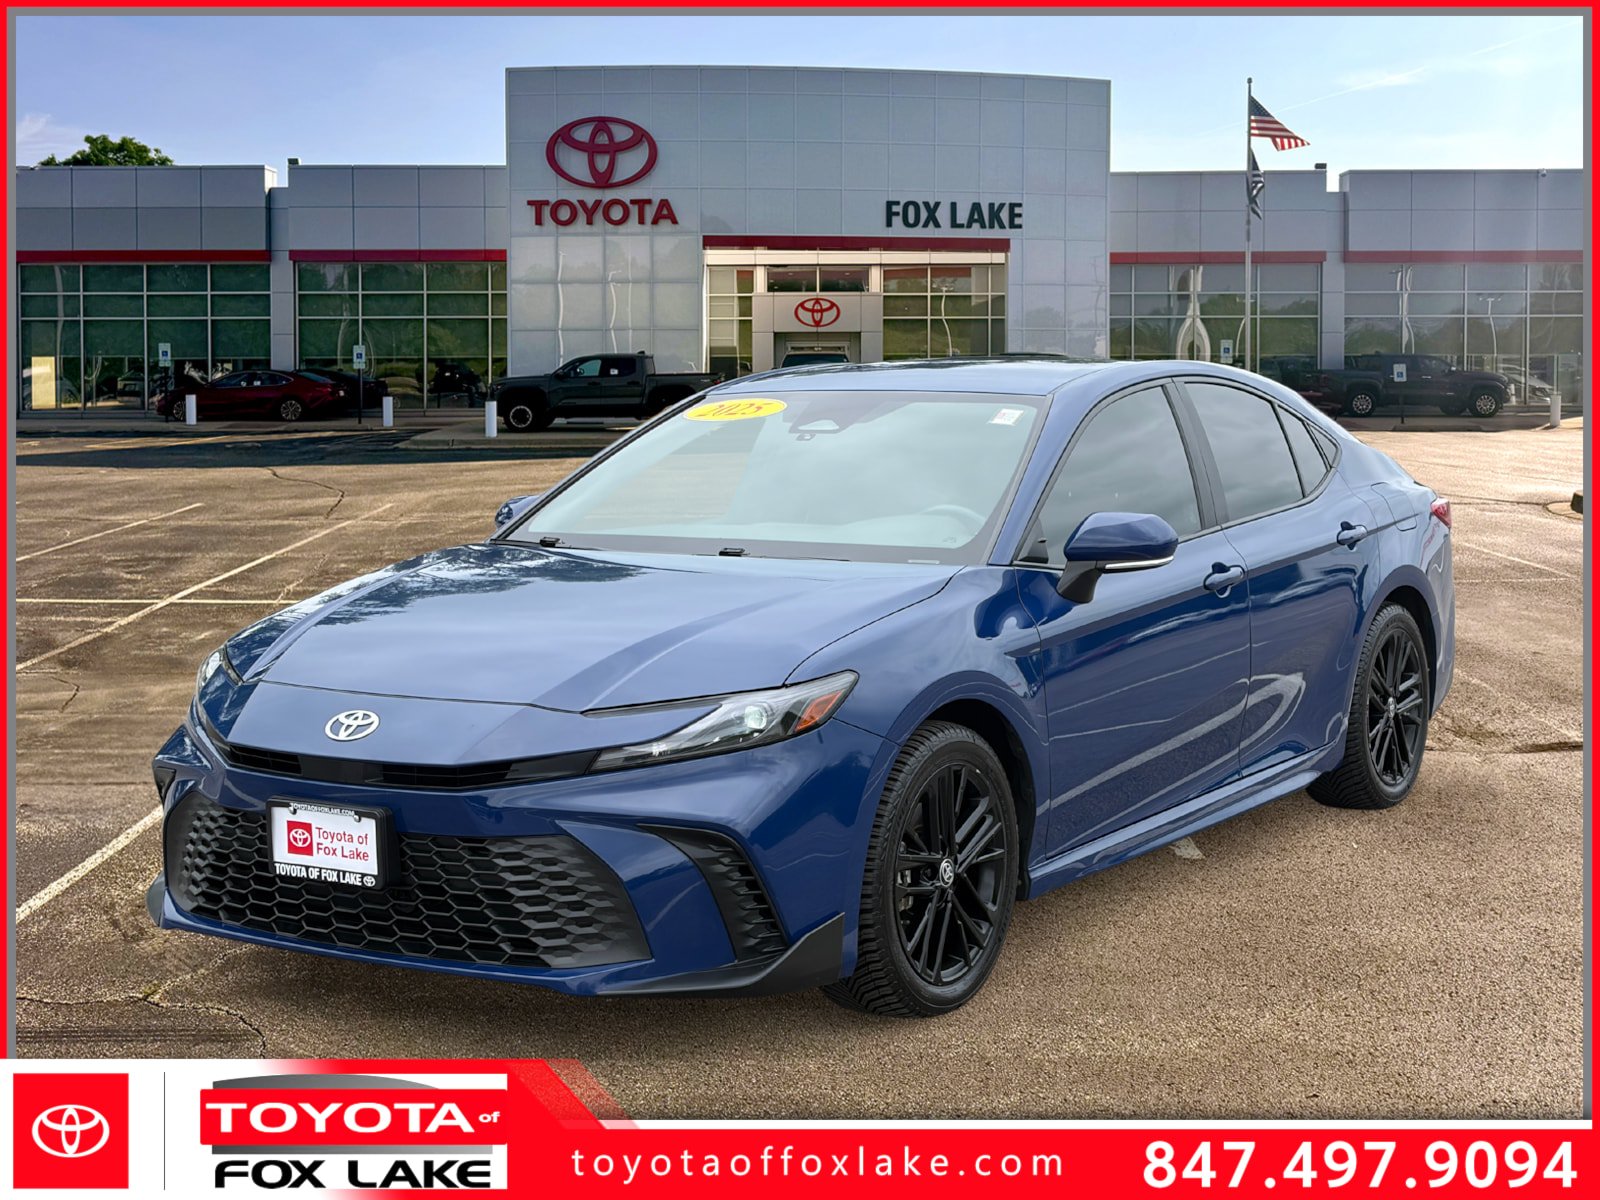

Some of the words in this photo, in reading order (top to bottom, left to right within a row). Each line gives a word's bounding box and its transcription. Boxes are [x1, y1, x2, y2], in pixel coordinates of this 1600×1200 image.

[527, 199, 679, 226] TOYOTA
[885, 201, 942, 228] FOX
[950, 201, 1023, 229] LAKE
[694, 402, 775, 417] 2025
[315, 826, 354, 844] Toyota
[357, 833, 369, 846] of
[316, 843, 338, 857] Fox
[341, 846, 370, 862] Lake
[274, 863, 307, 878] TOYOTA
[308, 868, 320, 879] OF
[321, 869, 339, 882] FOX
[340, 872, 363, 886] LAKE
